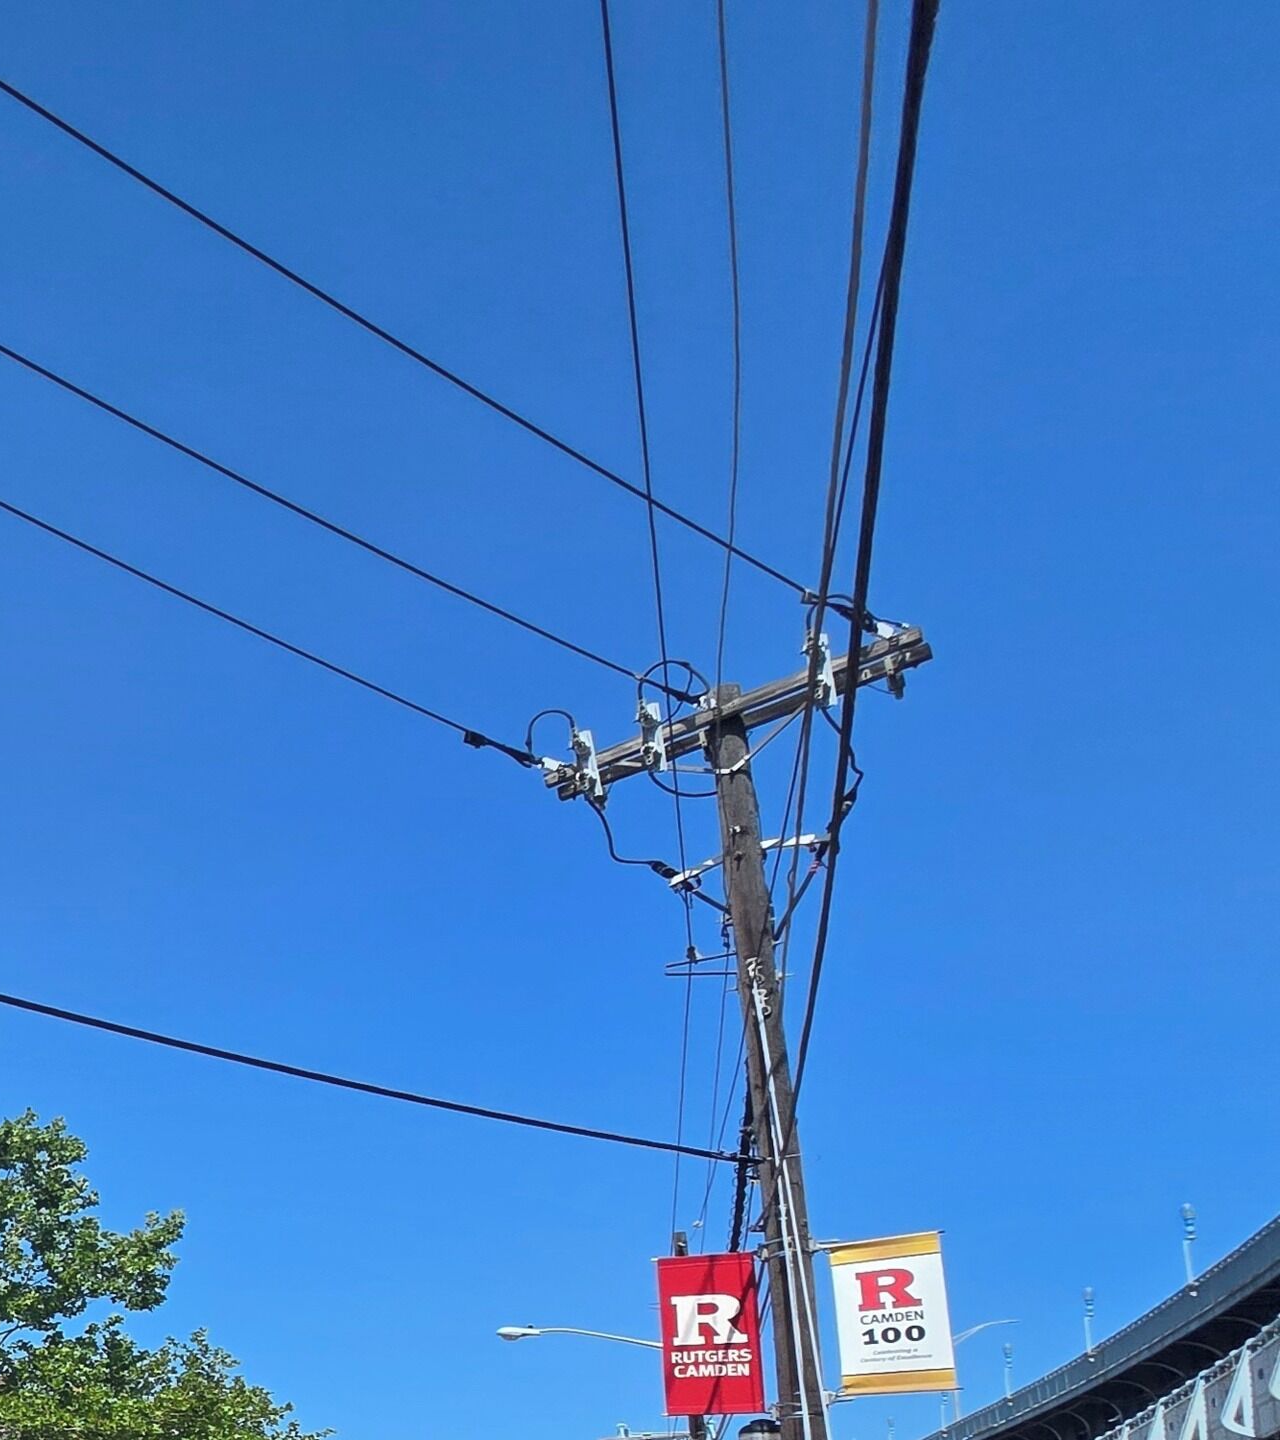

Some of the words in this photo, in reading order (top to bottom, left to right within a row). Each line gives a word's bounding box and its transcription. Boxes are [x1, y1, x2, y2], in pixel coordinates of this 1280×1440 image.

[855, 1268, 923, 1312] R
[670, 1294, 749, 1346] R
[860, 1310, 925, 1325] CAMDEN
[861, 1325, 926, 1346] 100
[671, 1348, 753, 1364] RUTGERS
[674, 1363, 750, 1378] CAMDEN
